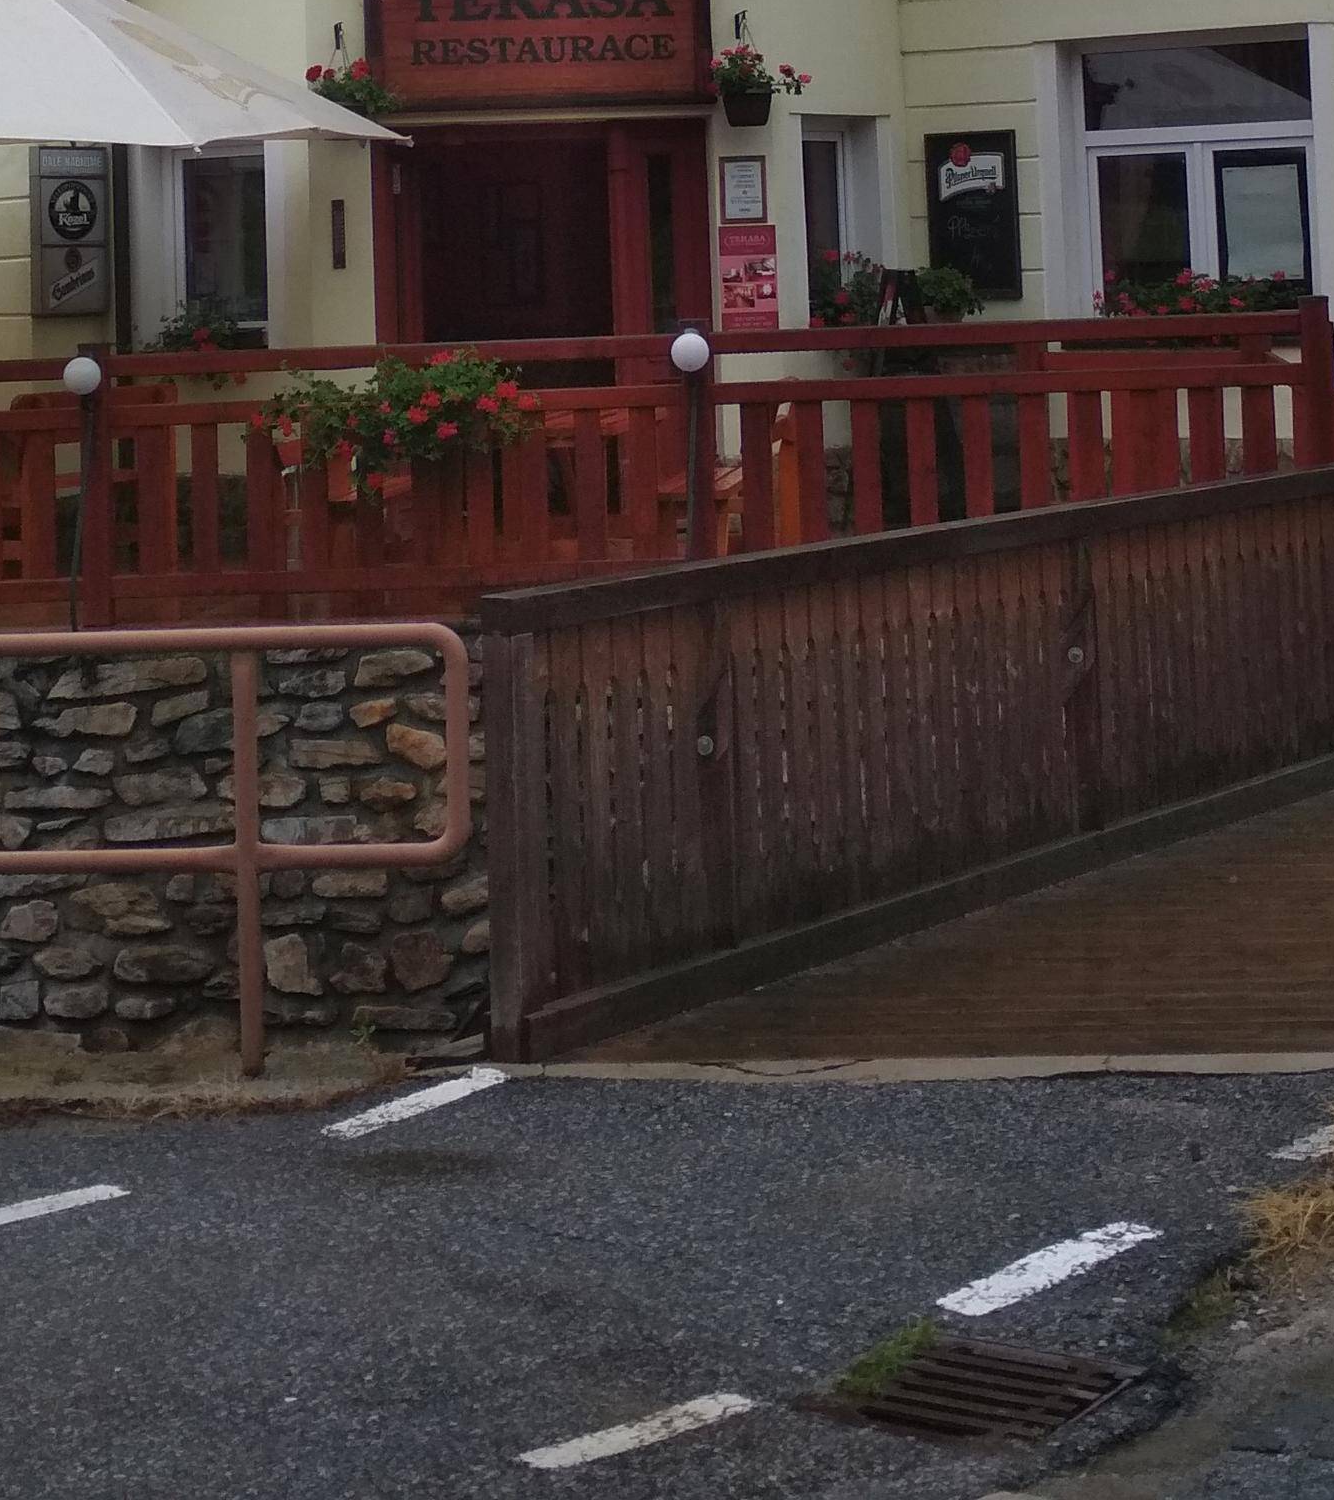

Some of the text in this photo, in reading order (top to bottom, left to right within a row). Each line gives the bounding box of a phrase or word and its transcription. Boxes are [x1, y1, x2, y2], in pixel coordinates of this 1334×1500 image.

[410, 33, 676, 66] RESTAURACE
[945, 165, 997, 190] Pilsner Urquell
[58, 212, 90, 227] Kozel
